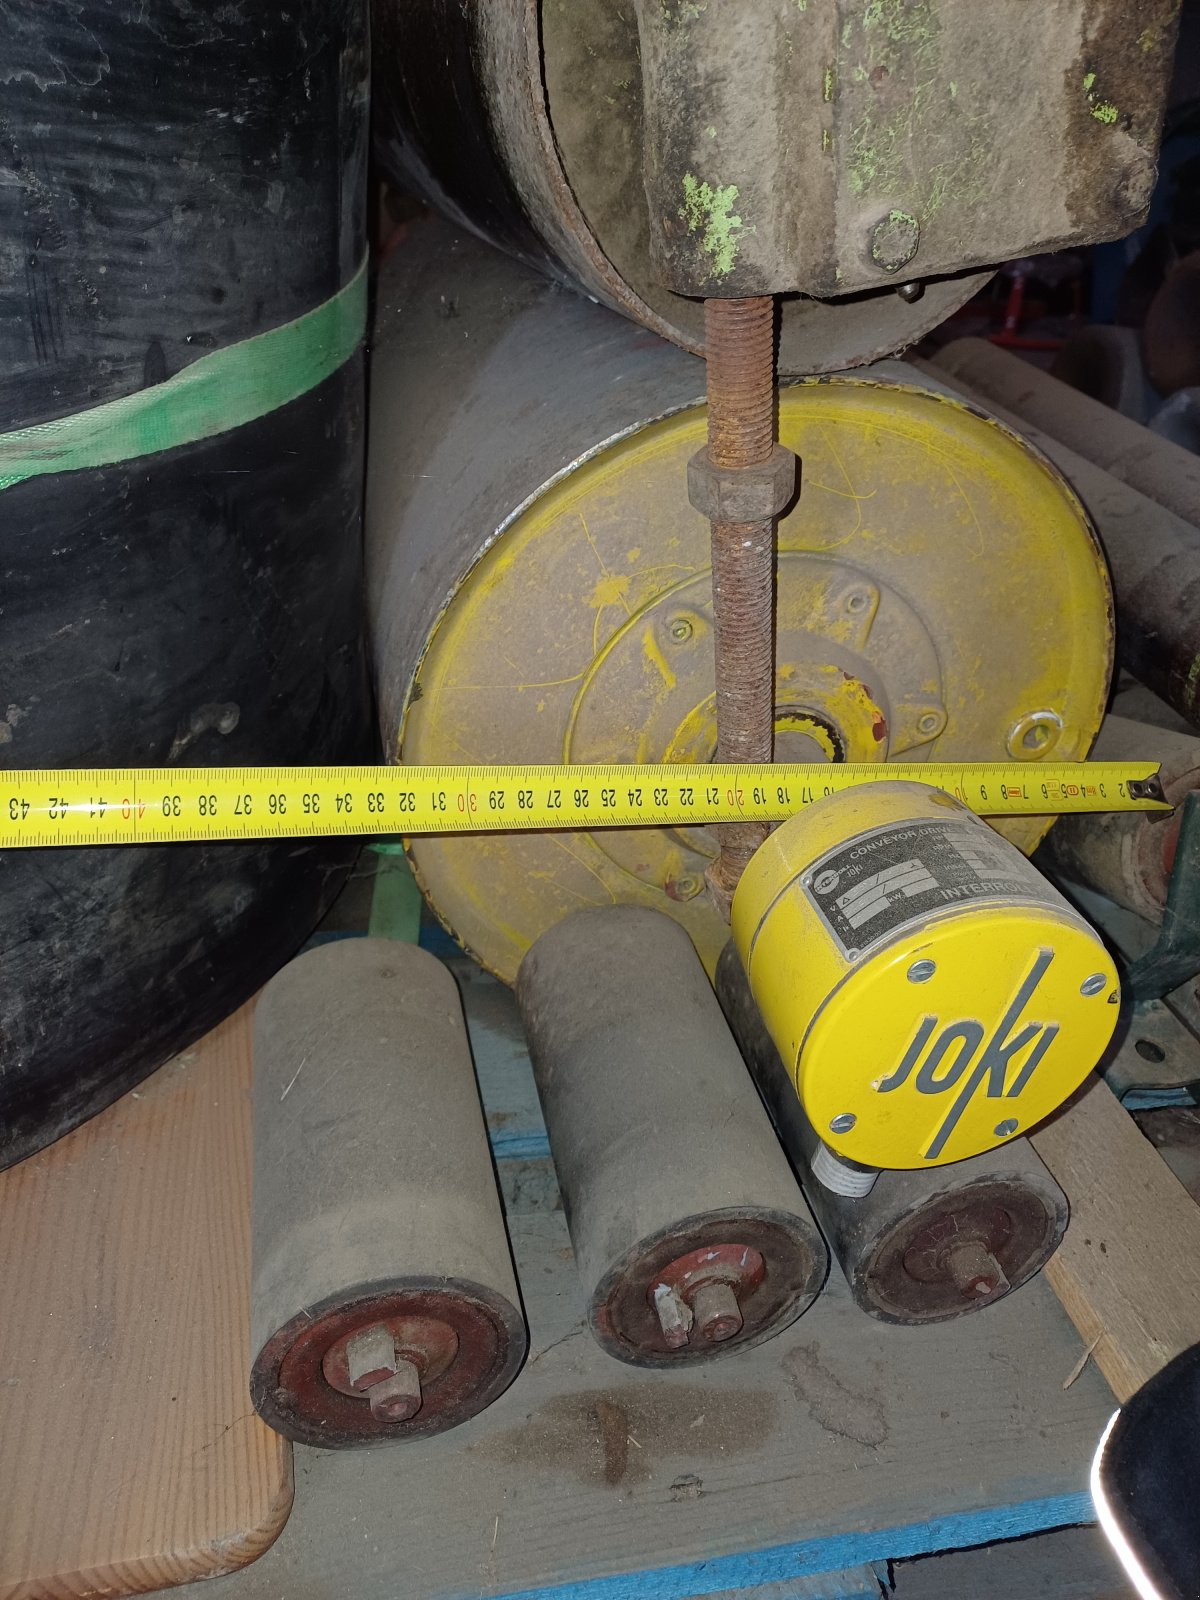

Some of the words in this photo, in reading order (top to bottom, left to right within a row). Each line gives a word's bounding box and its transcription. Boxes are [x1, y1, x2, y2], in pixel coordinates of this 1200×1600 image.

[489, 790, 505, 810] 29
[518, 790, 534, 809] 28
[546, 789, 562, 808] 27
[574, 789, 589, 808] 26
[601, 788, 617, 807] 25
[627, 788, 643, 807] 24
[654, 788, 669, 806] 23
[680, 788, 694, 806] 22
[706, 787, 719, 805] 21
[727, 789, 745, 806] 20
[753, 787, 767, 804] 19
[776, 787, 791, 804] 18
[802, 787, 814, 804] 17
[980, 784, 987, 800] 9
[1000, 784, 1008, 800] 8
[1022, 784, 1030, 800] 7
[1041, 784, 1049, 799] 6
[1060, 784, 1068, 798] 5
[1080, 784, 1087, 798] 4
[1098, 783, 1107, 798] 3
[9, 798, 30, 820] 43
[48, 797, 69, 820] 42
[90, 796, 108, 819] 41
[122, 798, 146, 820] 40
[162, 795, 182, 817] 39
[198, 794, 218, 816] 38
[234, 794, 252, 815] 37
[268, 794, 287, 814] 36
[303, 793, 320, 814] 35
[335, 792, 353, 813] 34
[367, 792, 385, 813] 33
[399, 792, 416, 812] 32
[432, 792, 447, 811] 31
[457, 792, 478, 812] 30
[850, 829, 917, 859] CONVEYOR
